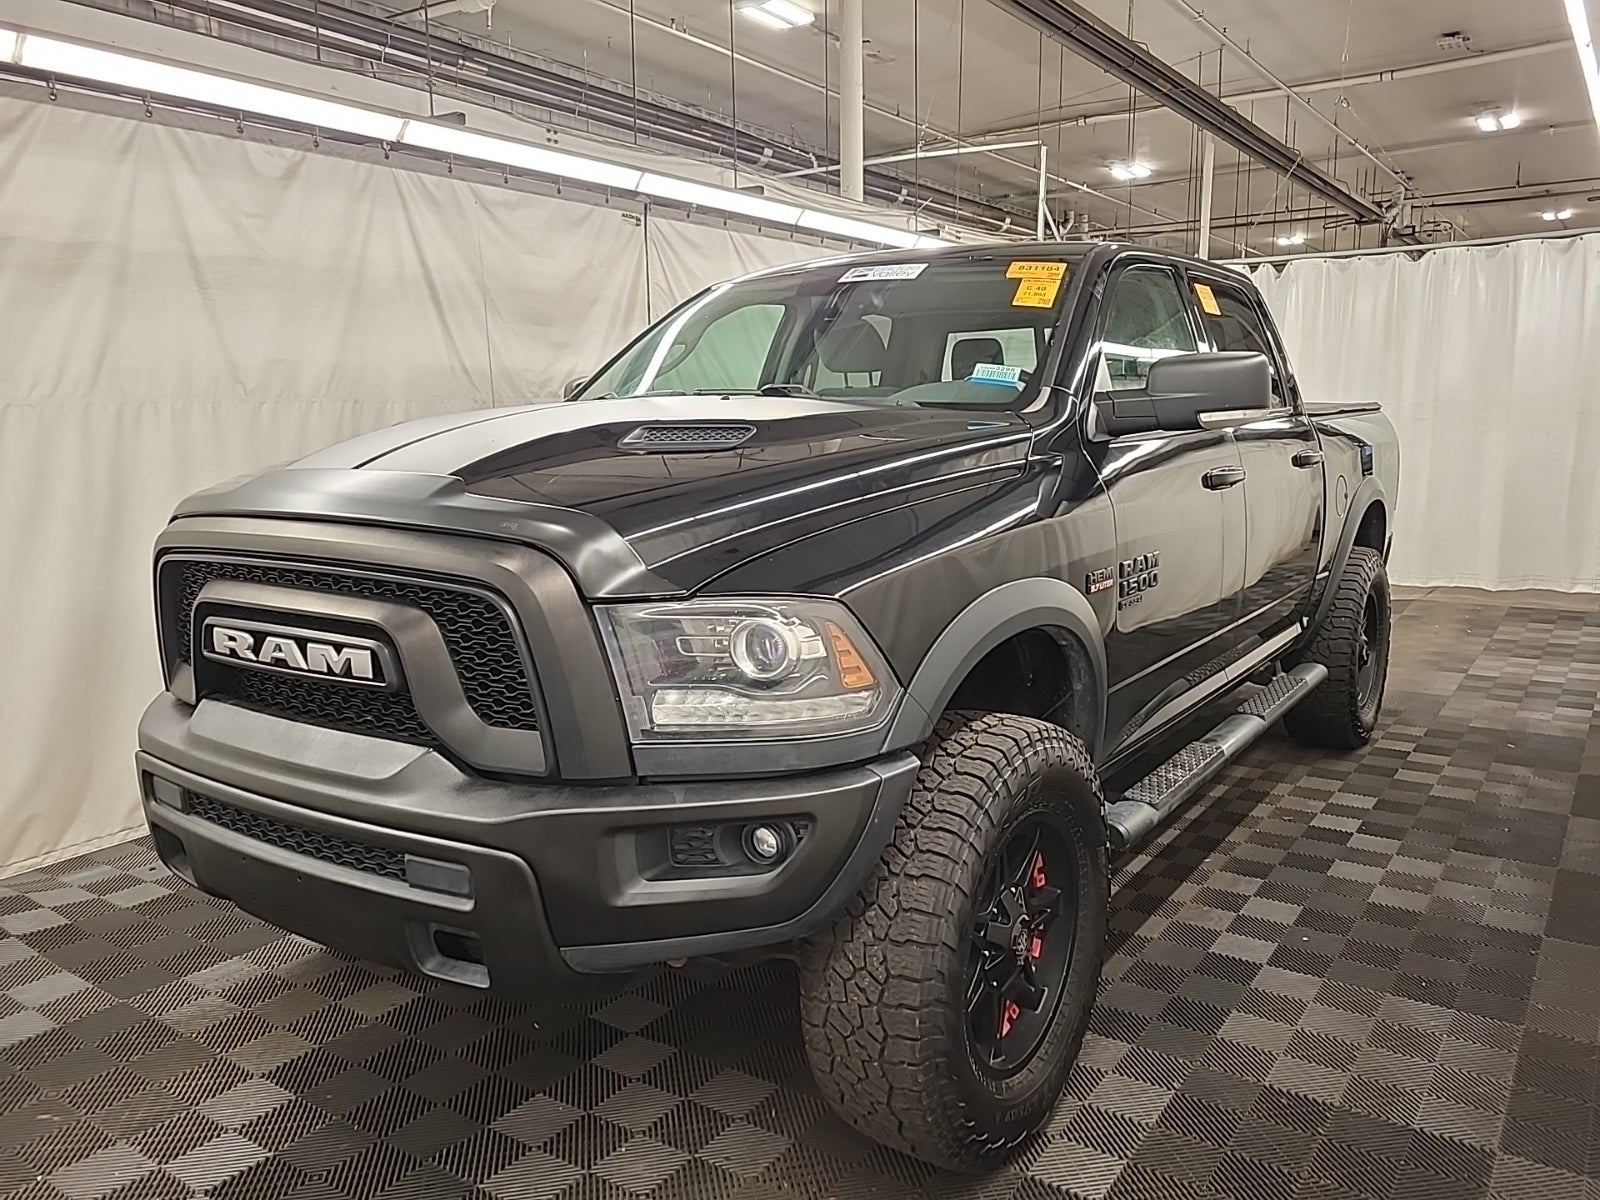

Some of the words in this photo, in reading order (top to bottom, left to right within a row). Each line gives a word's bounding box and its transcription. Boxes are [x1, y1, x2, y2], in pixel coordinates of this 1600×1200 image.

[1118, 550, 1160, 579] RAM
[1118, 570, 1159, 599] 1500
[213, 626, 374, 680] RAM
